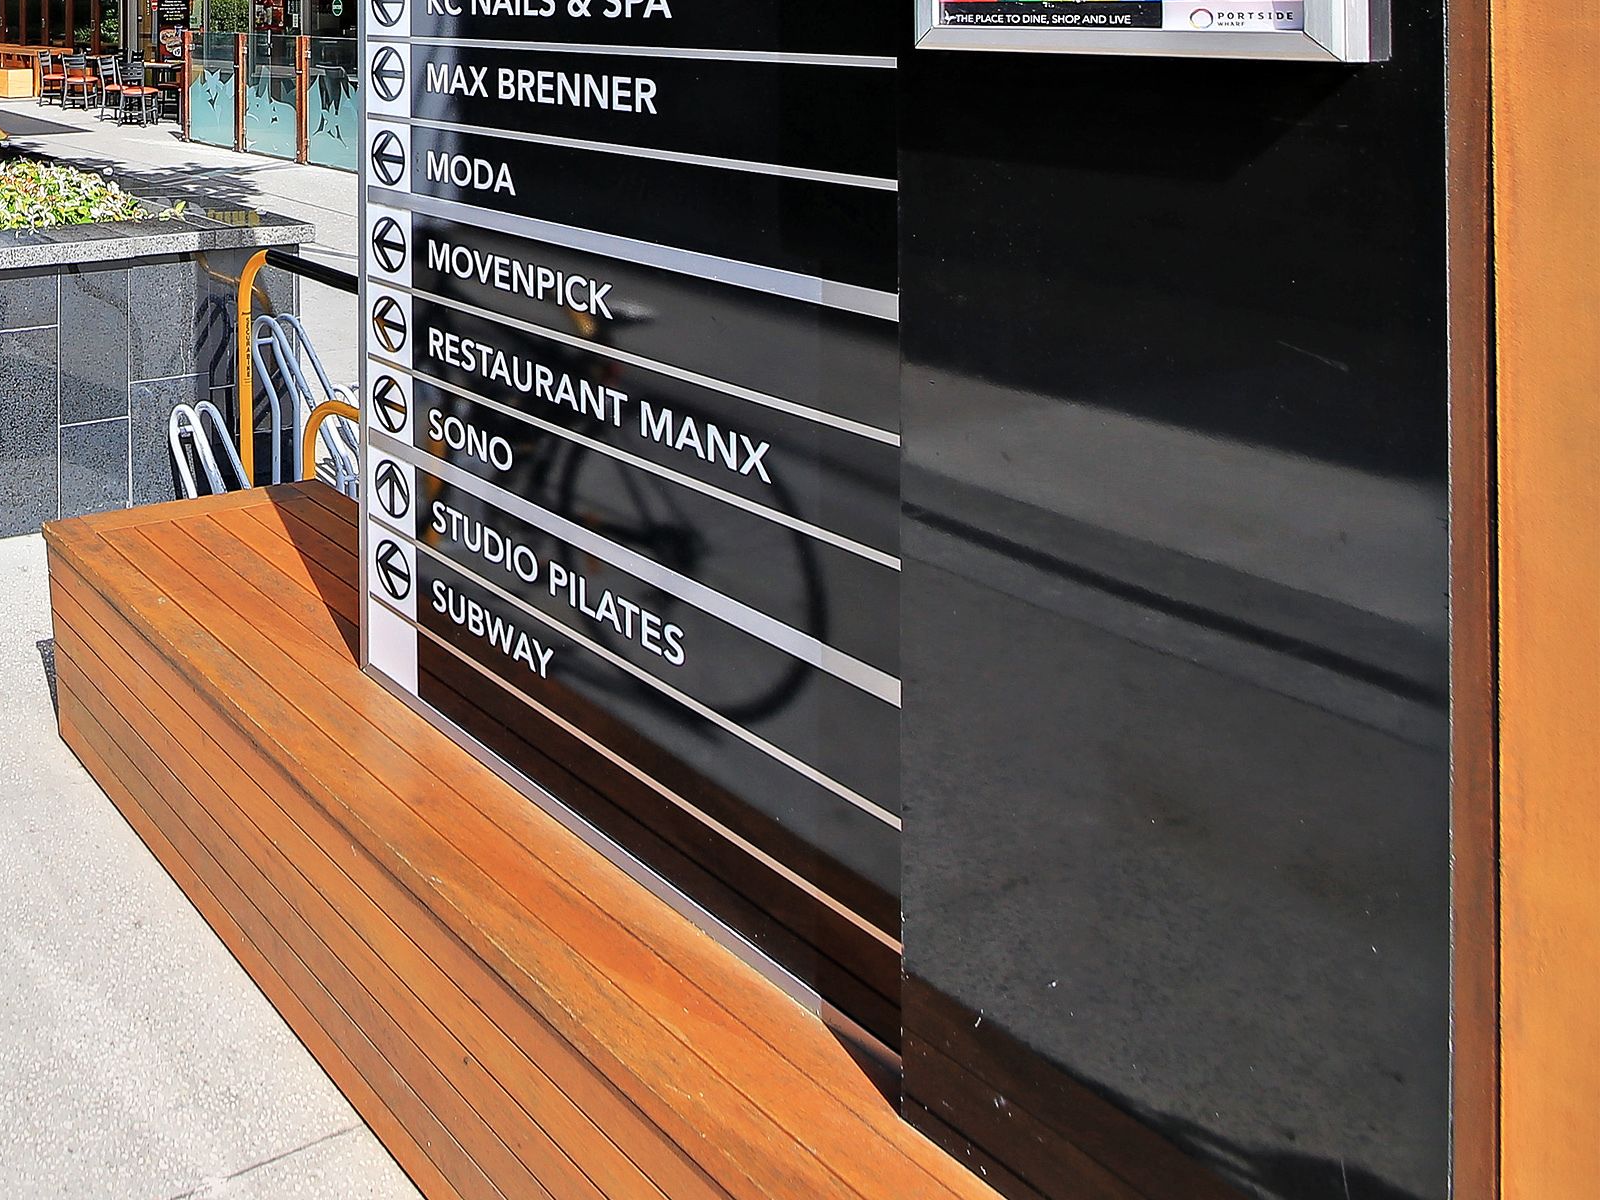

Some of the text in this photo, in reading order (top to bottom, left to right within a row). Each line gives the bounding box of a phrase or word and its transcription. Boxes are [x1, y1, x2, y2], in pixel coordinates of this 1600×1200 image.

[956, 14, 1132, 24] THE PLACE TO DINE, SHOP AND LIVE
[1217, 12, 1294, 20] PORTSIDE
[426, 62, 658, 115] MAX BRENNER
[426, 150, 516, 196] MODA
[427, 239, 614, 320] MOVENPICK
[428, 326, 772, 485] RESTAURANT MANX
[428, 408, 513, 471] SONO
[432, 501, 686, 666] STUDIO PILATES
[431, 579, 555, 680] SUBWAY
